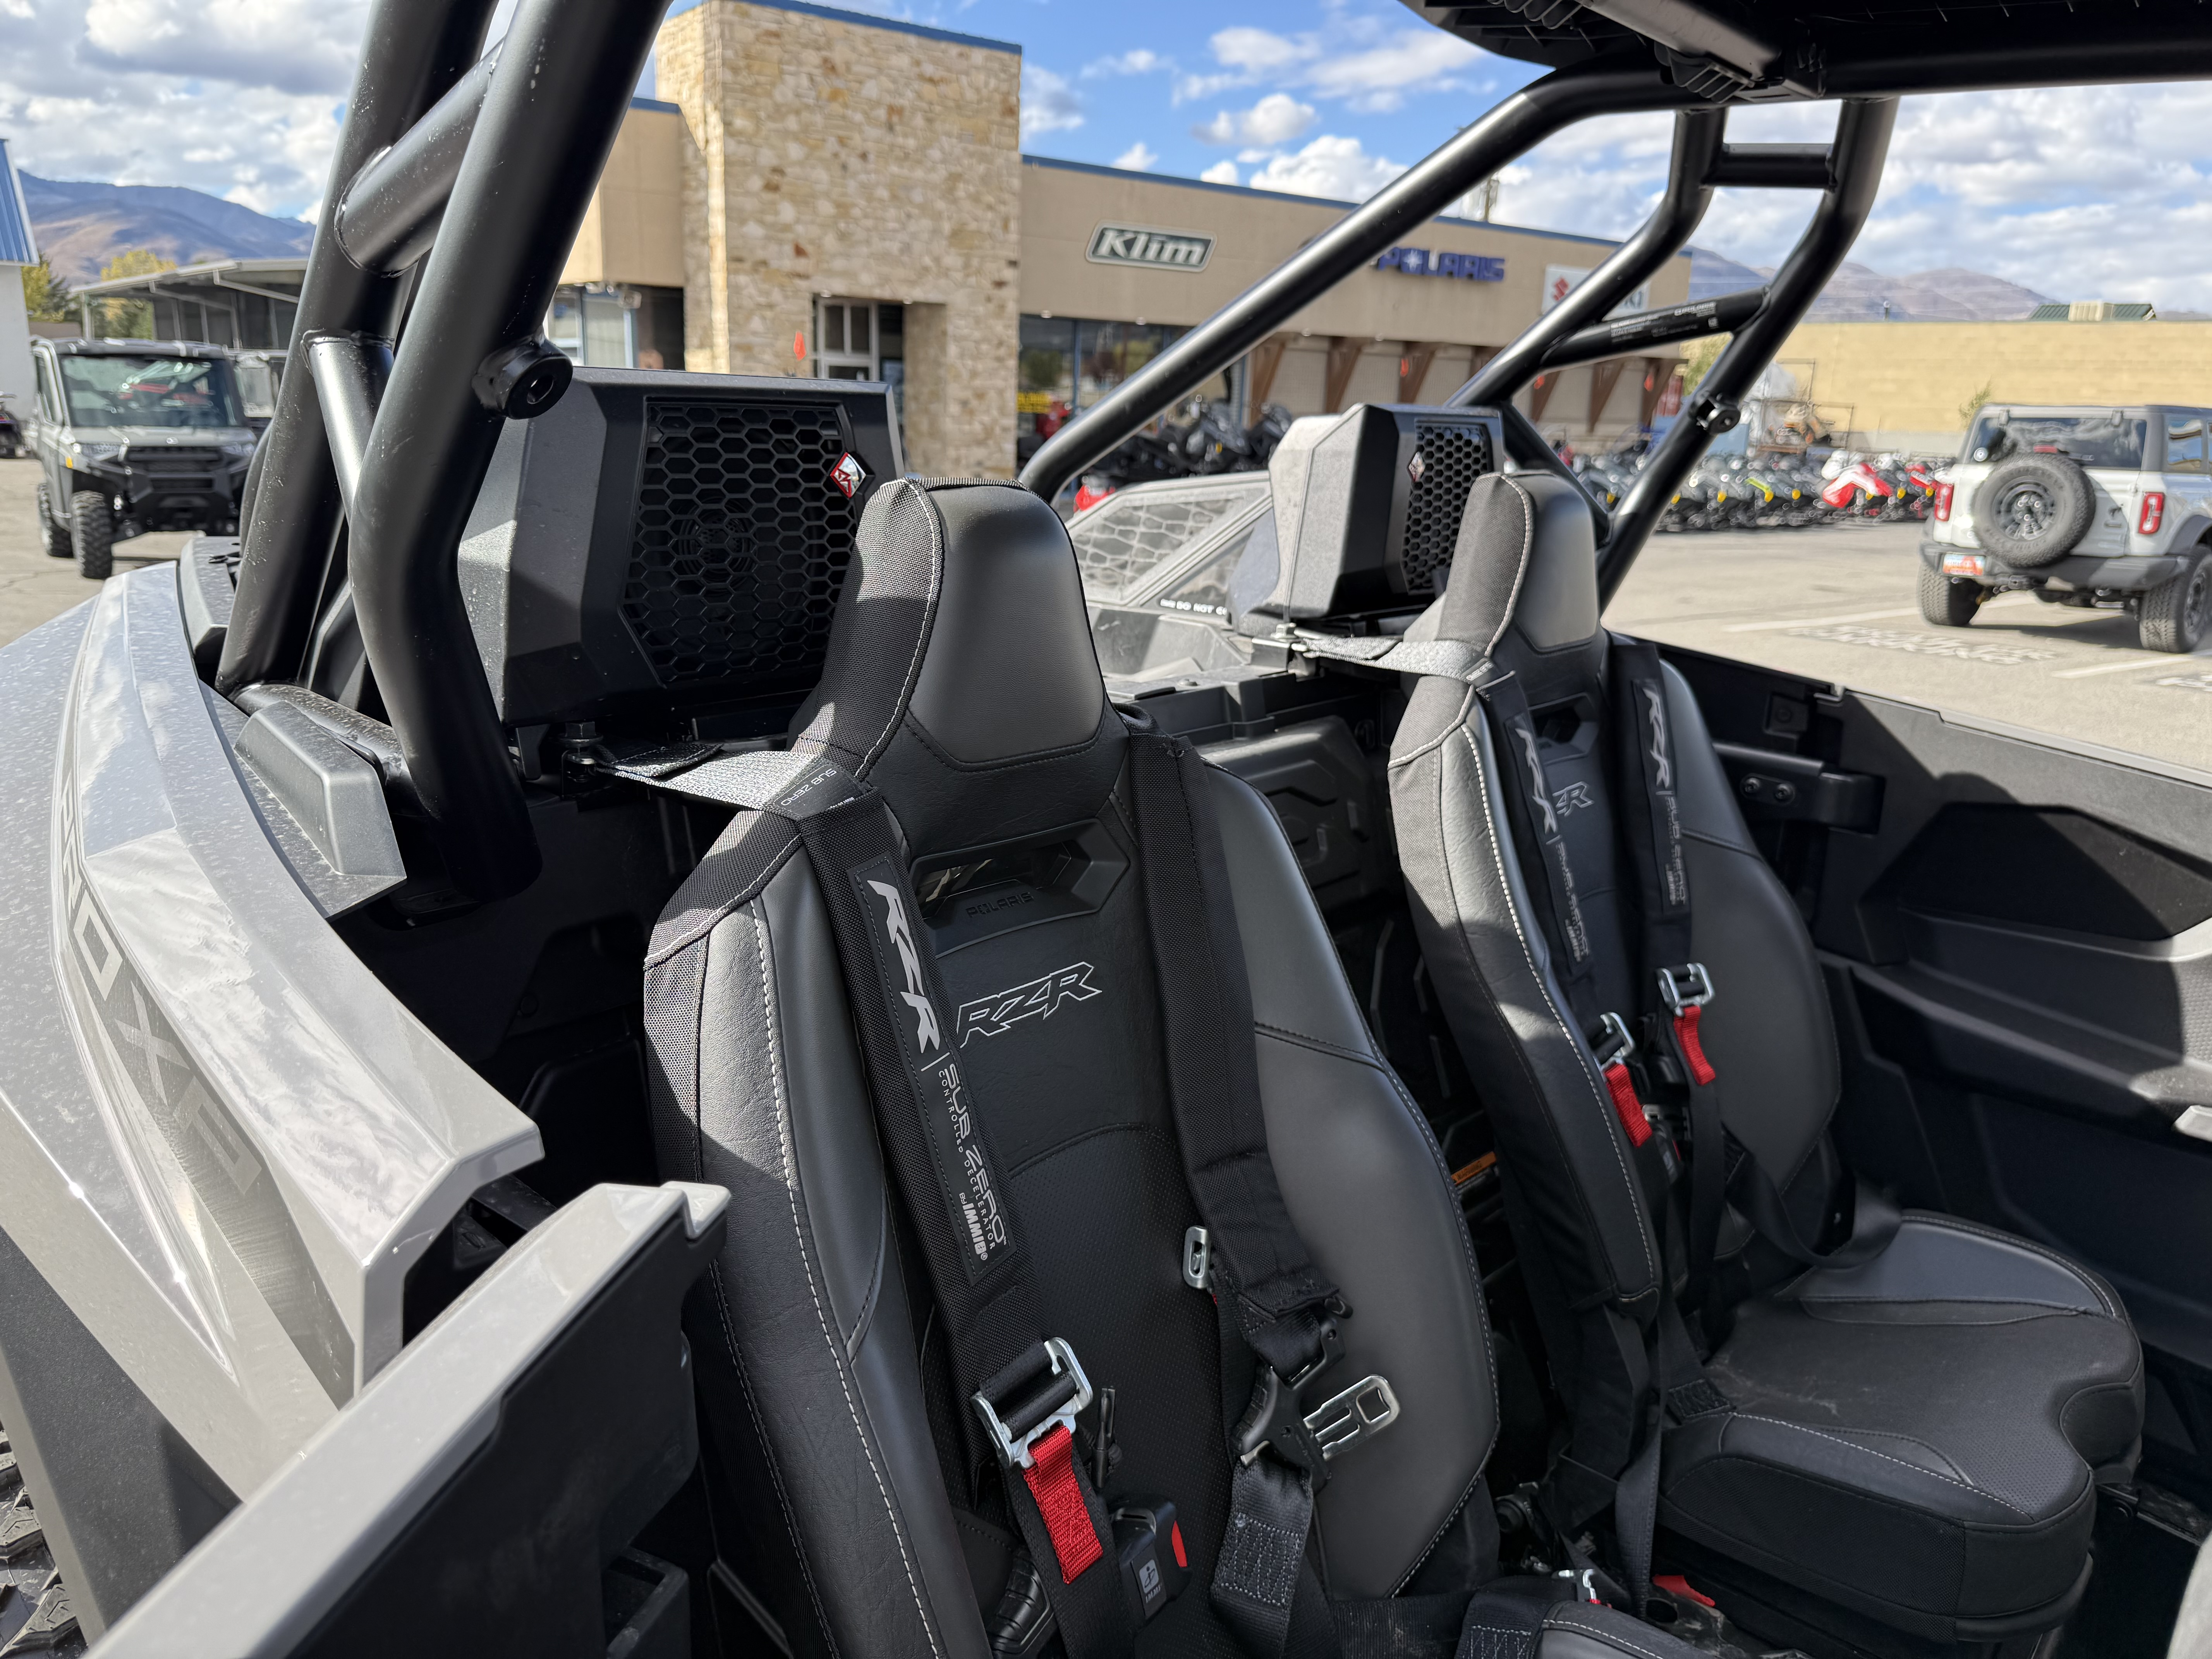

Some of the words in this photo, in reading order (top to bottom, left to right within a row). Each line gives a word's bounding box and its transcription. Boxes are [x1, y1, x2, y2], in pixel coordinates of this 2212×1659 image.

[1377, 247, 1505, 282] POLARIS
[780, 784, 813, 806] ZERO
[811, 768, 837, 785] SUB
[965, 891, 1034, 917] POLARIS
[867, 880, 940, 1053] RZR
[957, 962, 1103, 1049] RZR
[944, 1063, 970, 1139] SUB
[938, 1070, 963, 1153] CONTROLLED
[964, 1159, 995, 1250] DECELERATOR
